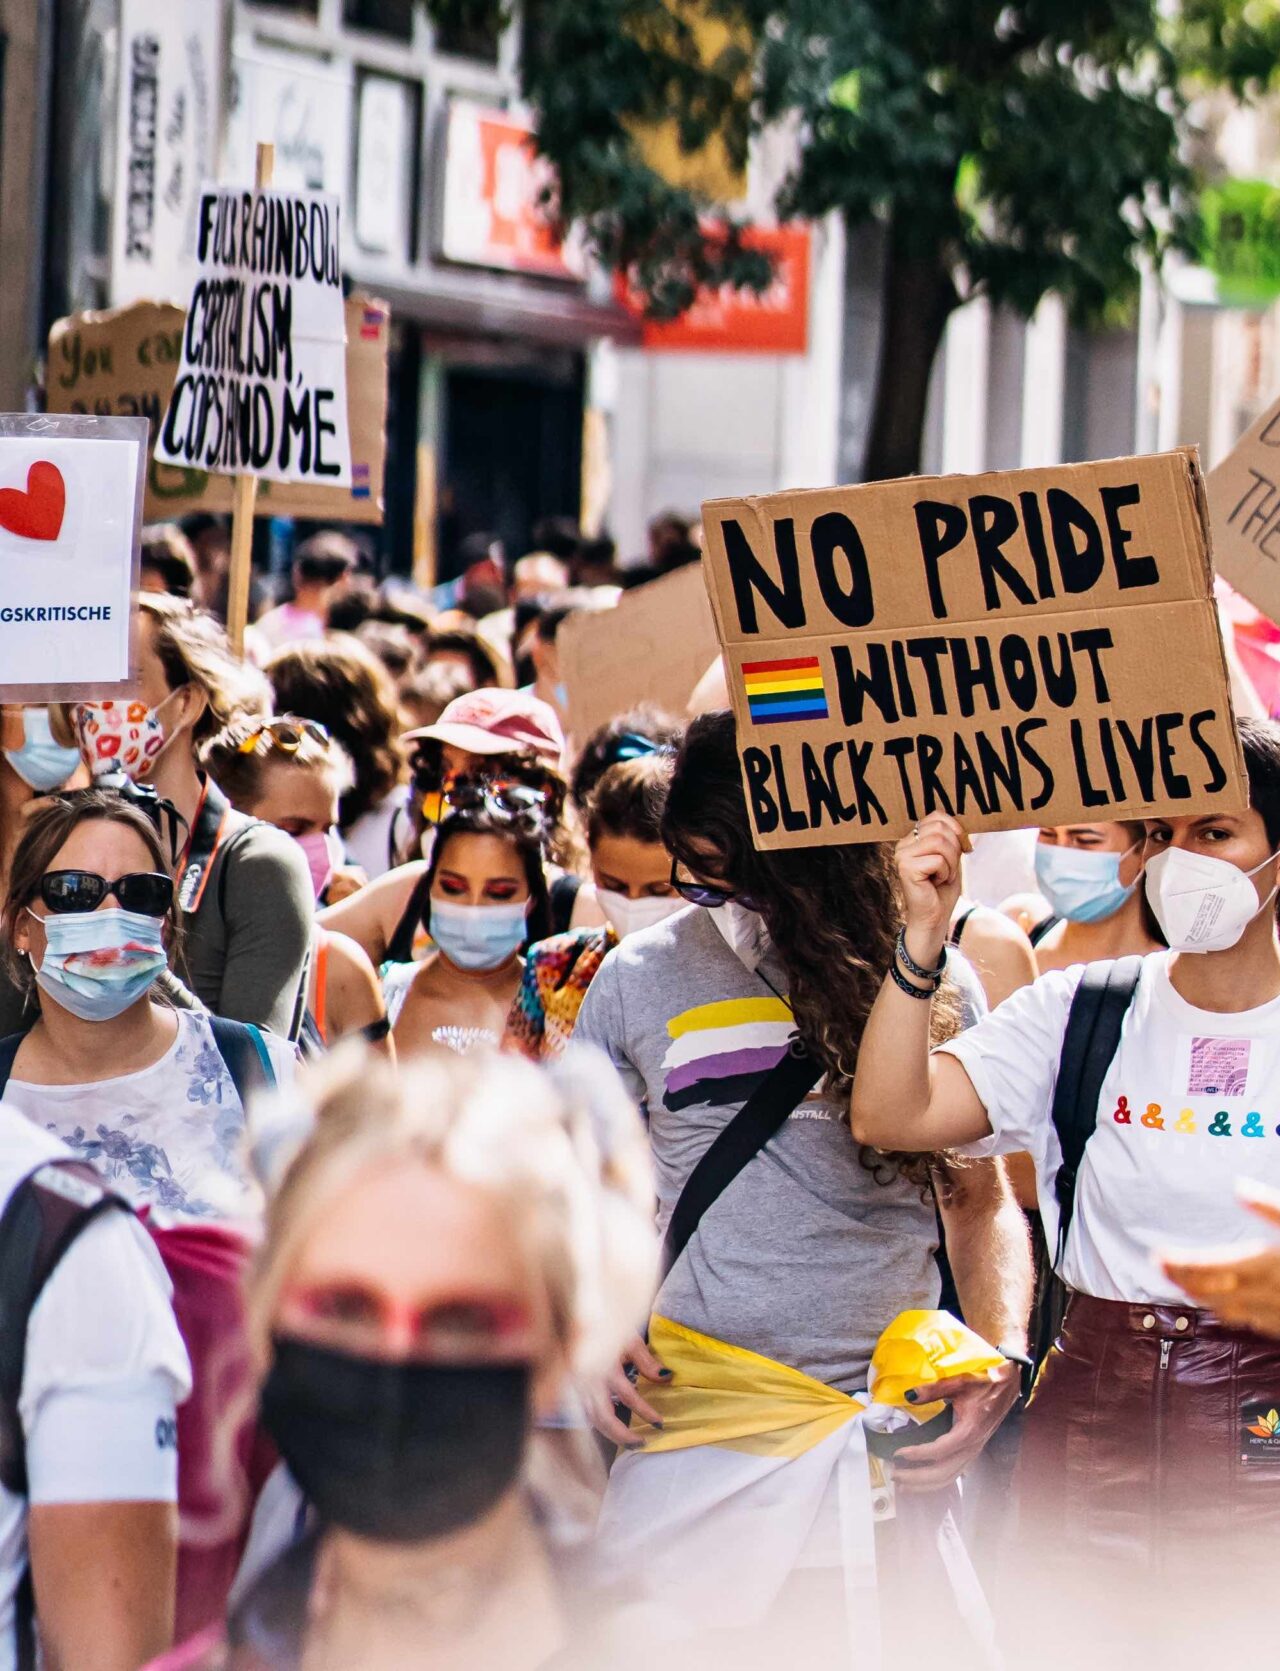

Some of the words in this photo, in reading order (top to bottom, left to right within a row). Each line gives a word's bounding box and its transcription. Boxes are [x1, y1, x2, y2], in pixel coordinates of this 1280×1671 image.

[238, 193, 341, 288] RAINBOW
[222, 378, 275, 470] AND
[277, 385, 342, 478] ME
[721, 511, 875, 634] NO
[913, 483, 1160, 620] PRIDE
[831, 627, 1114, 727] WITHOUT
[742, 738, 888, 834] BLACK
[883, 717, 1055, 821] TRANS
[1069, 708, 1229, 808] LIVES
